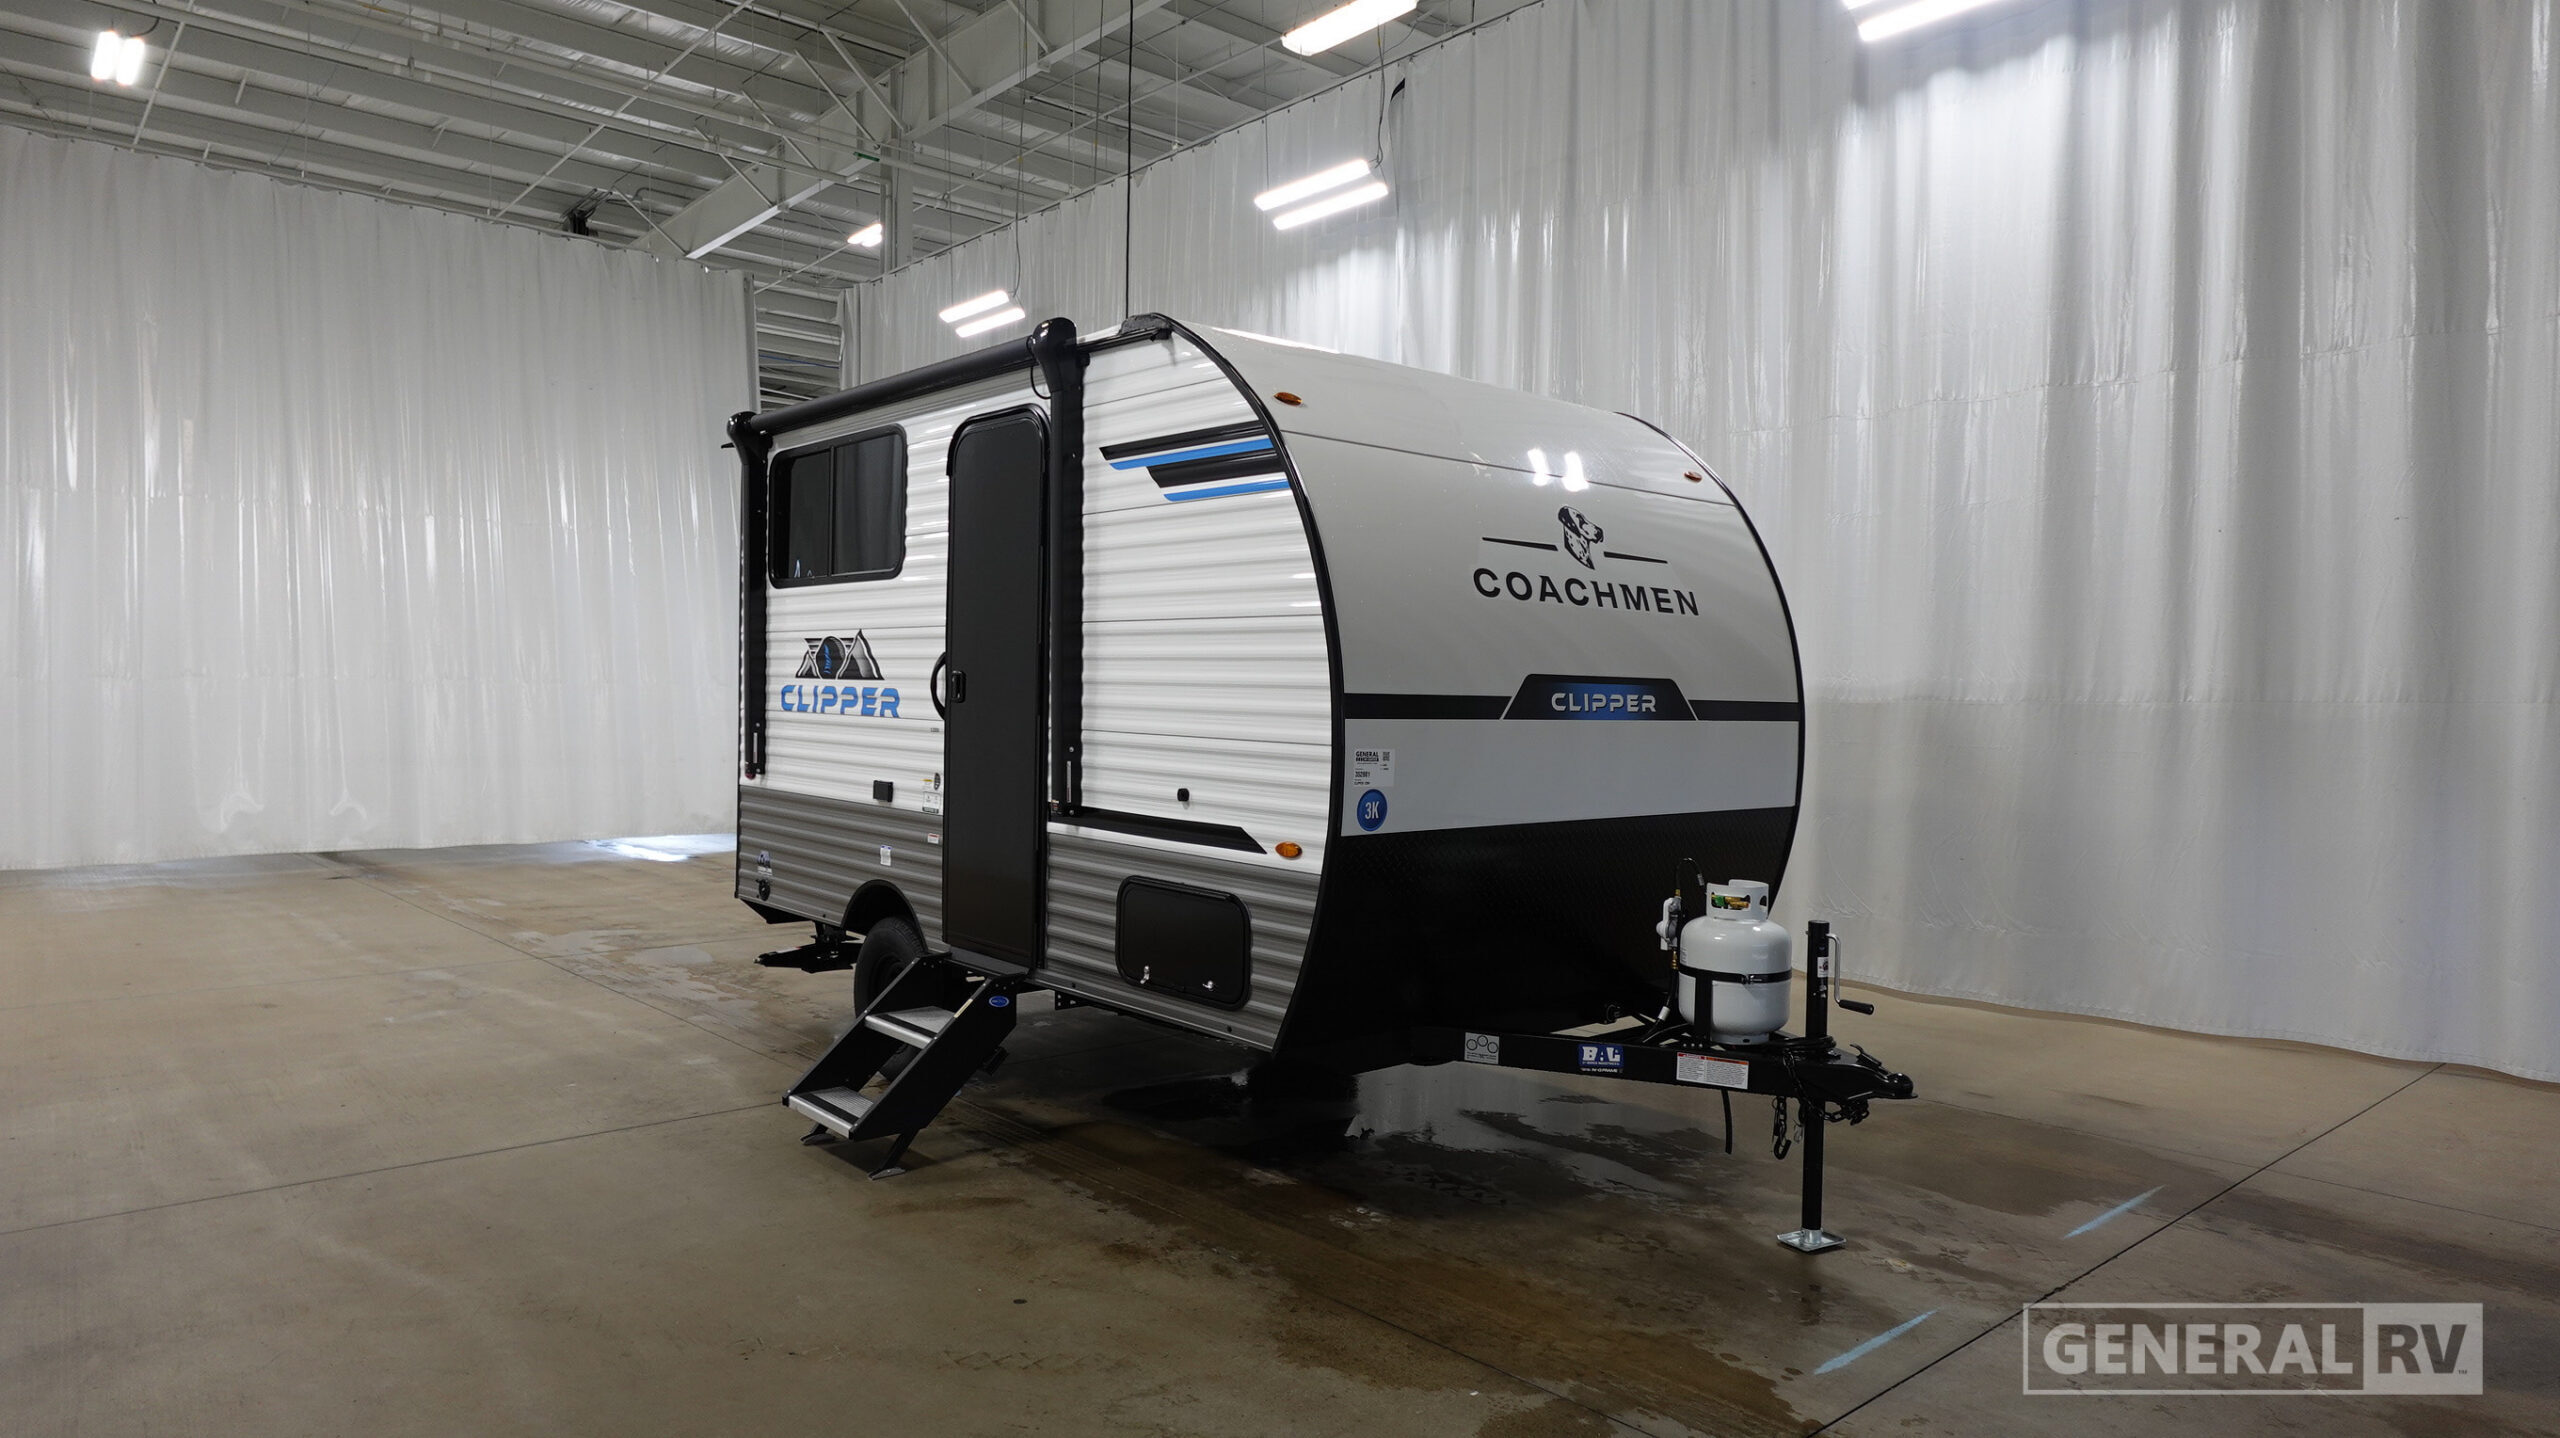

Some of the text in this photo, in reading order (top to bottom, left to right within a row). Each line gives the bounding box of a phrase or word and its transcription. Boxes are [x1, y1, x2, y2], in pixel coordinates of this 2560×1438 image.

[1473, 568, 1699, 616] COACHMEN
[781, 685, 900, 718] CLIPPER
[1551, 693, 1656, 712] CLIPPER
[1365, 801, 1380, 819] 3K
